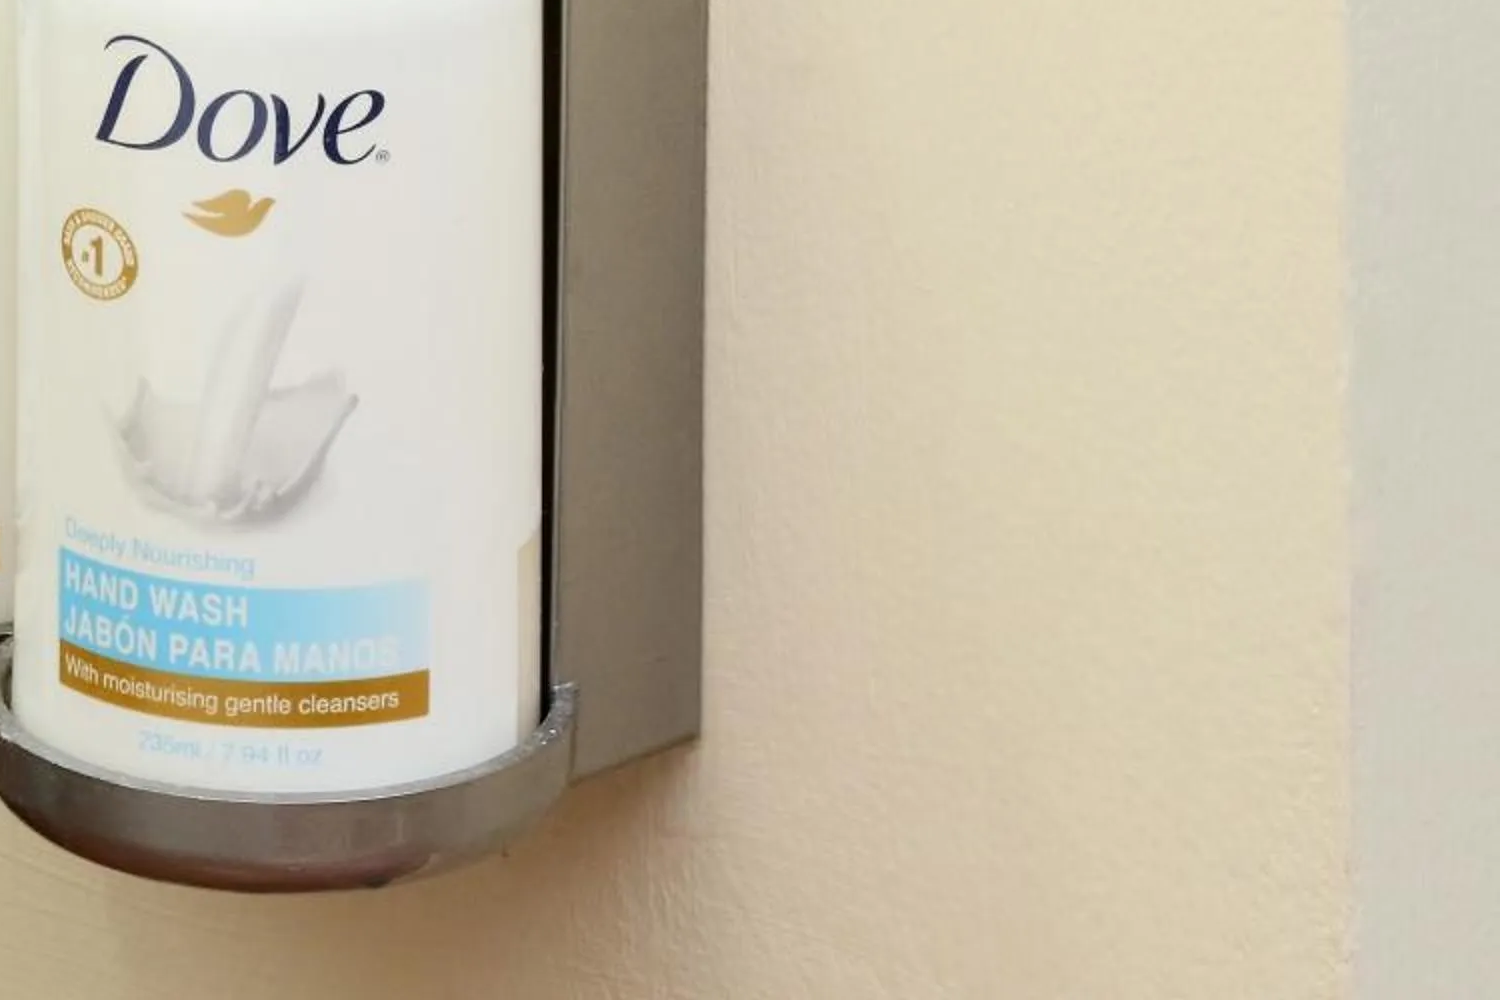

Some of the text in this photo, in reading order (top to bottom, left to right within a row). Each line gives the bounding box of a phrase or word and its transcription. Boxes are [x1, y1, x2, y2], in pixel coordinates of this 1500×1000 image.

[133, 536, 257, 581] Nourishing
[65, 558, 248, 629] HAND WASH
[64, 604, 400, 676] JABÓN PARA MANOS
[64, 653, 400, 717] With moisturising gentle cleansers
[221, 740, 269, 766] 794
